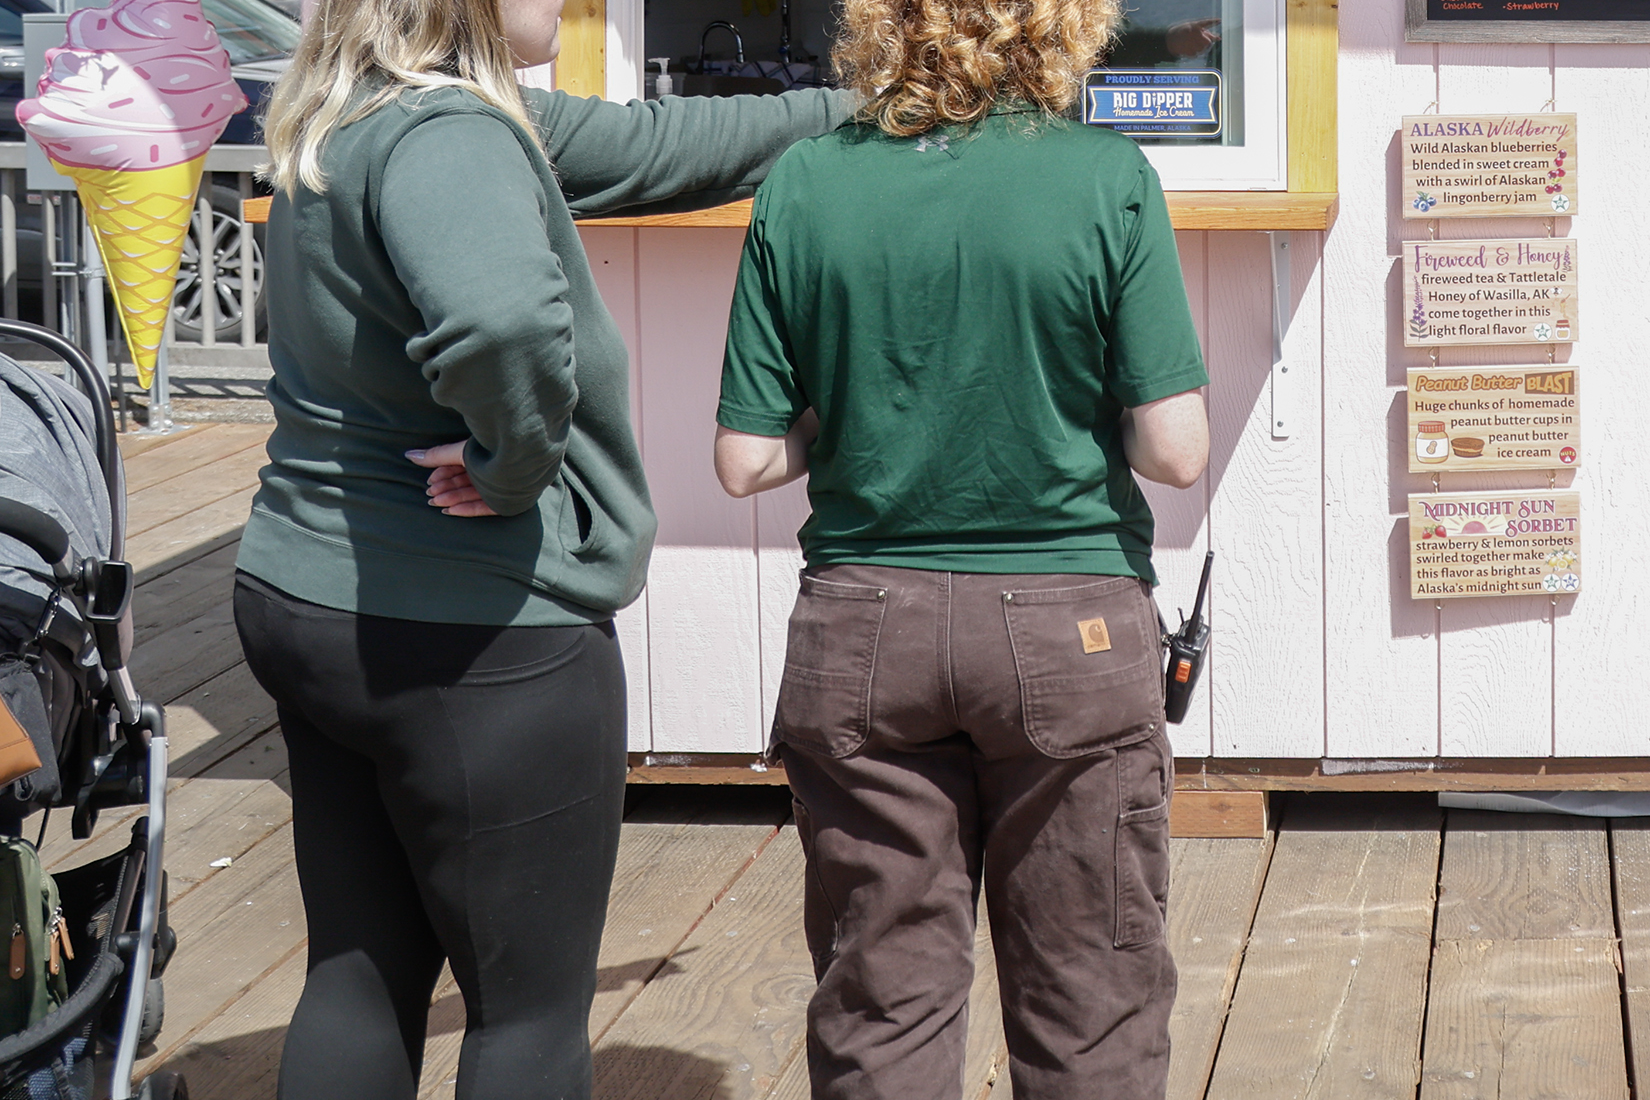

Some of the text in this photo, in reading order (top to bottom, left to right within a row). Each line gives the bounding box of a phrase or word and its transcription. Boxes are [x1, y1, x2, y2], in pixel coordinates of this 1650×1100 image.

[1443, 2, 1483, 10] Chocolate
[1506, 2, 1559, 10] Strawberry
[1153, 75, 1199, 83] SERVING
[1113, 92, 1137, 108] BIG
[1113, 105, 1194, 118] Homemade Ice Cream
[1410, 117, 1570, 142] ALASKA Wildberry
[1411, 141, 1557, 153] Wild Alaskan blueberries
[1412, 159, 1549, 170] blended in sweet cream
[1416, 176, 1442, 186] with
[1454, 175, 1483, 186] swirl
[1485, 175, 1498, 185] of
[1499, 175, 1545, 185] Alaskan
[1443, 192, 1536, 205] lingonberry jam
[1414, 243, 1563, 273] Fireweed & Honey
[1428, 289, 1549, 303] Honey of Wasilla, AK
[1428, 306, 1550, 320] come together in this
[1416, 372, 1571, 393] Peanut Butter BLAST
[1415, 398, 1574, 413] Huge chunks of homemade
[1419, 500, 1555, 521] MIDNIGHT SUN
[1505, 518, 1577, 537] SORBET
